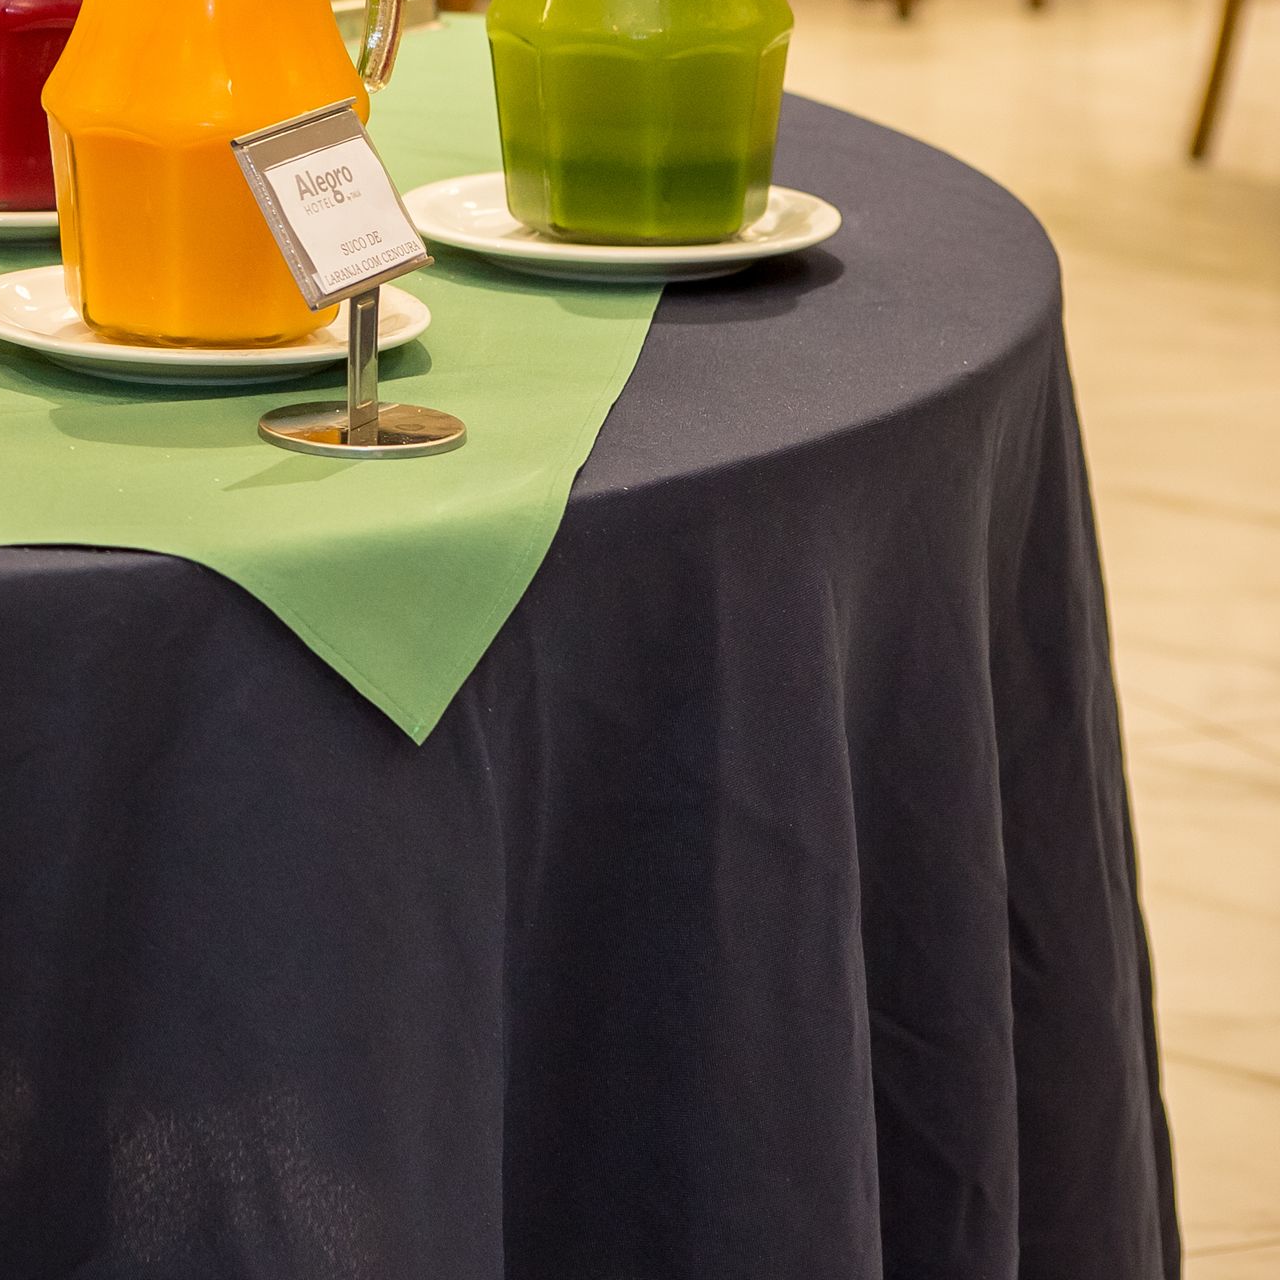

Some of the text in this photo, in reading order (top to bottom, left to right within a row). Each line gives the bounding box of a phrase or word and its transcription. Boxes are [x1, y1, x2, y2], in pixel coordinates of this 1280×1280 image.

[295, 166, 353, 203] Alegro
[303, 198, 336, 216] HOTEL
[340, 230, 382, 256] SUCO DE
[324, 240, 421, 286] LARANJA COM CENOURA
